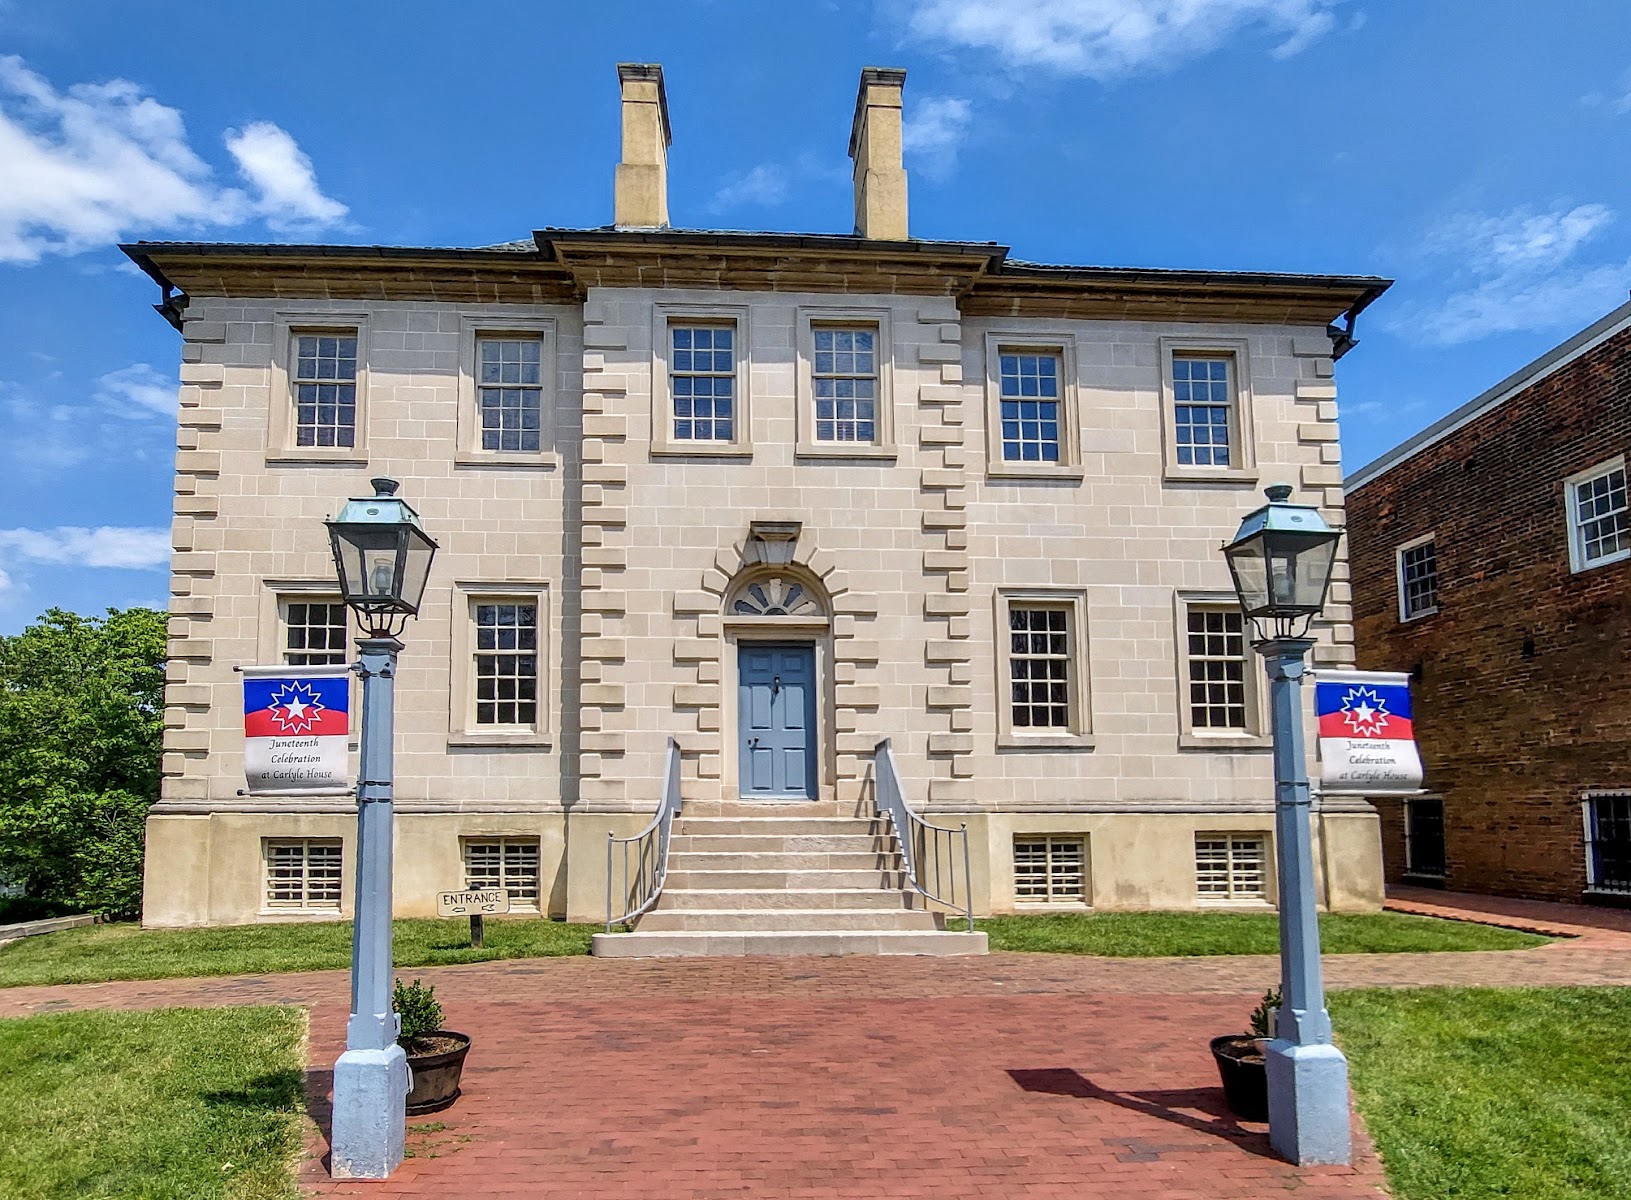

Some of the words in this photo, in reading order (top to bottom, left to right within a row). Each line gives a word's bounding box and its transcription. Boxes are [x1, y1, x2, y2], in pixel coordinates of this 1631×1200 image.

[269, 737, 319, 750] Juneteenth
[271, 753, 321, 764] Celebration
[1349, 754, 1397, 765] Celebration
[261, 771, 270, 779] at
[273, 768, 304, 782] Carlyle
[307, 768, 332, 779] House
[1339, 772, 1348, 780] at
[1351, 769, 1380, 783] Carlyle
[1383, 770, 1408, 780] House
[443, 892, 501, 905] ENTRANCE
